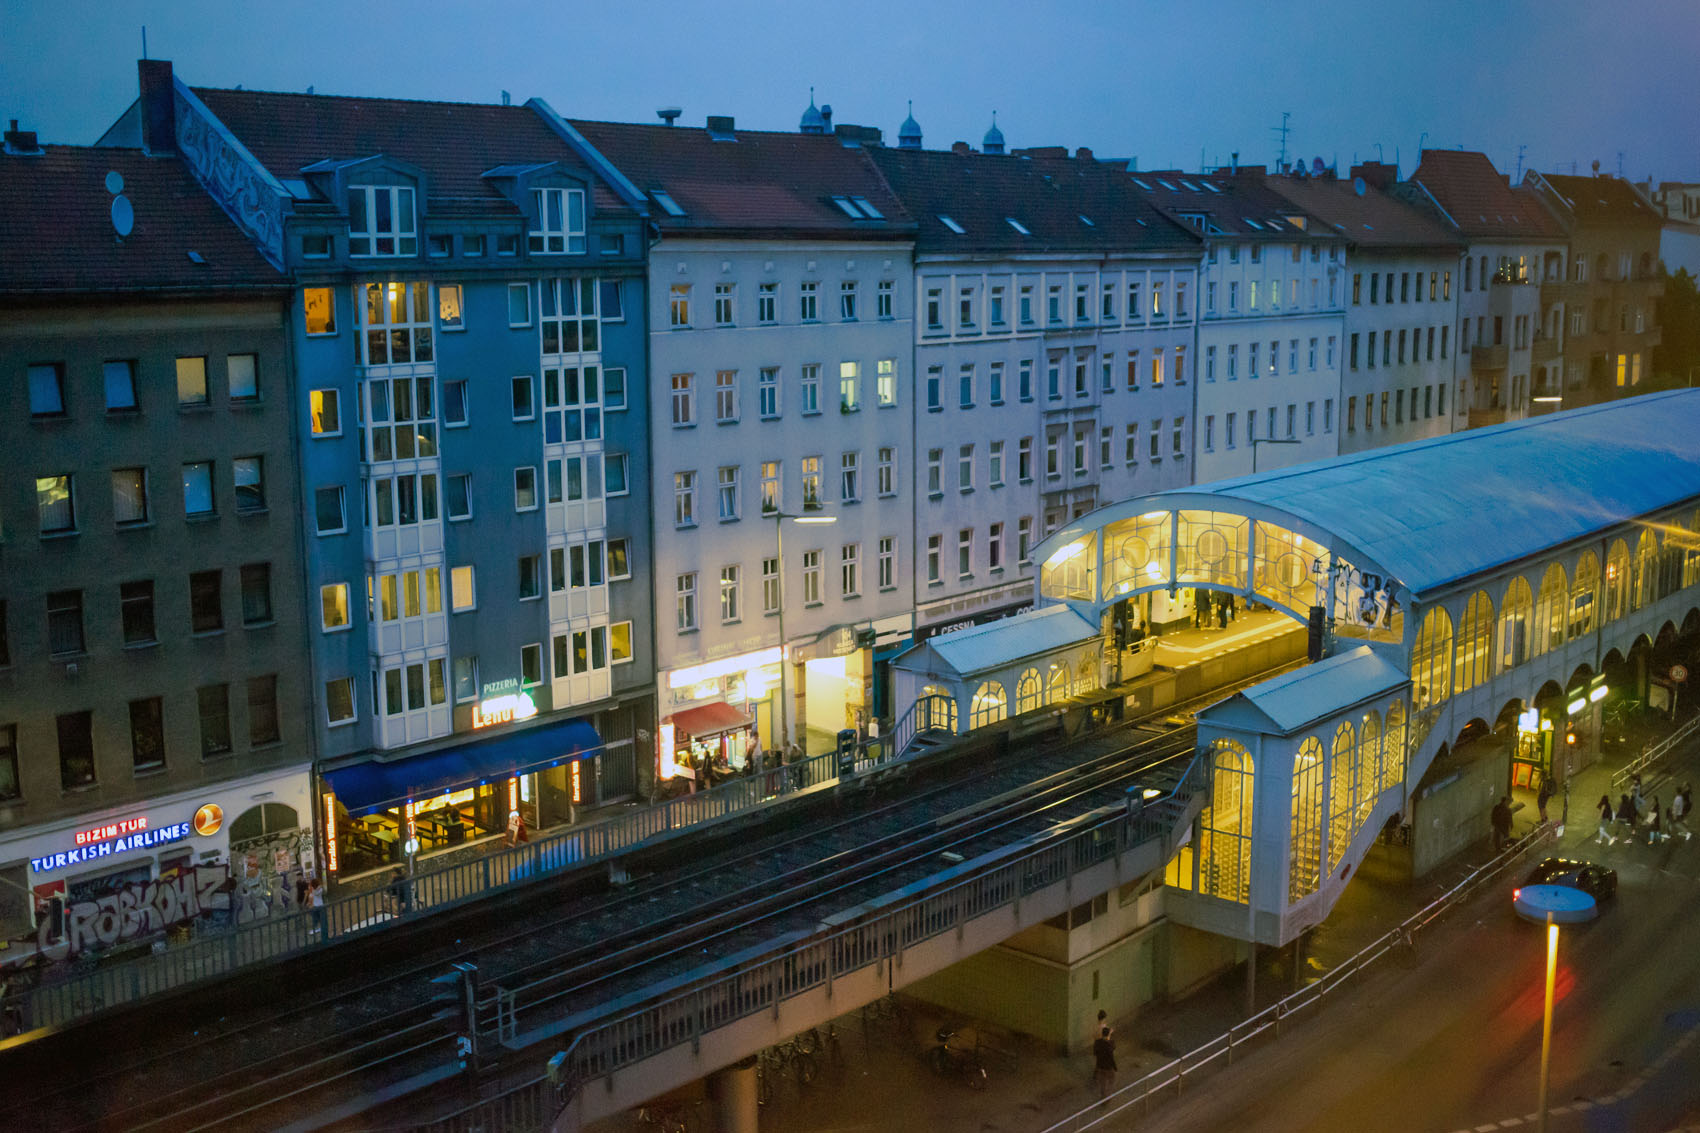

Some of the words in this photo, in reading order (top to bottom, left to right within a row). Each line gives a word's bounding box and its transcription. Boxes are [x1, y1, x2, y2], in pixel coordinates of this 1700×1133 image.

[941, 620, 976, 636] CESSNA
[483, 678, 518, 694] PIZZERIA
[76, 824, 118, 845] BIZIM
[120, 817, 148, 834] TUR
[31, 842, 111, 873] TURKISH
[114, 822, 190, 853] AIRLINES
